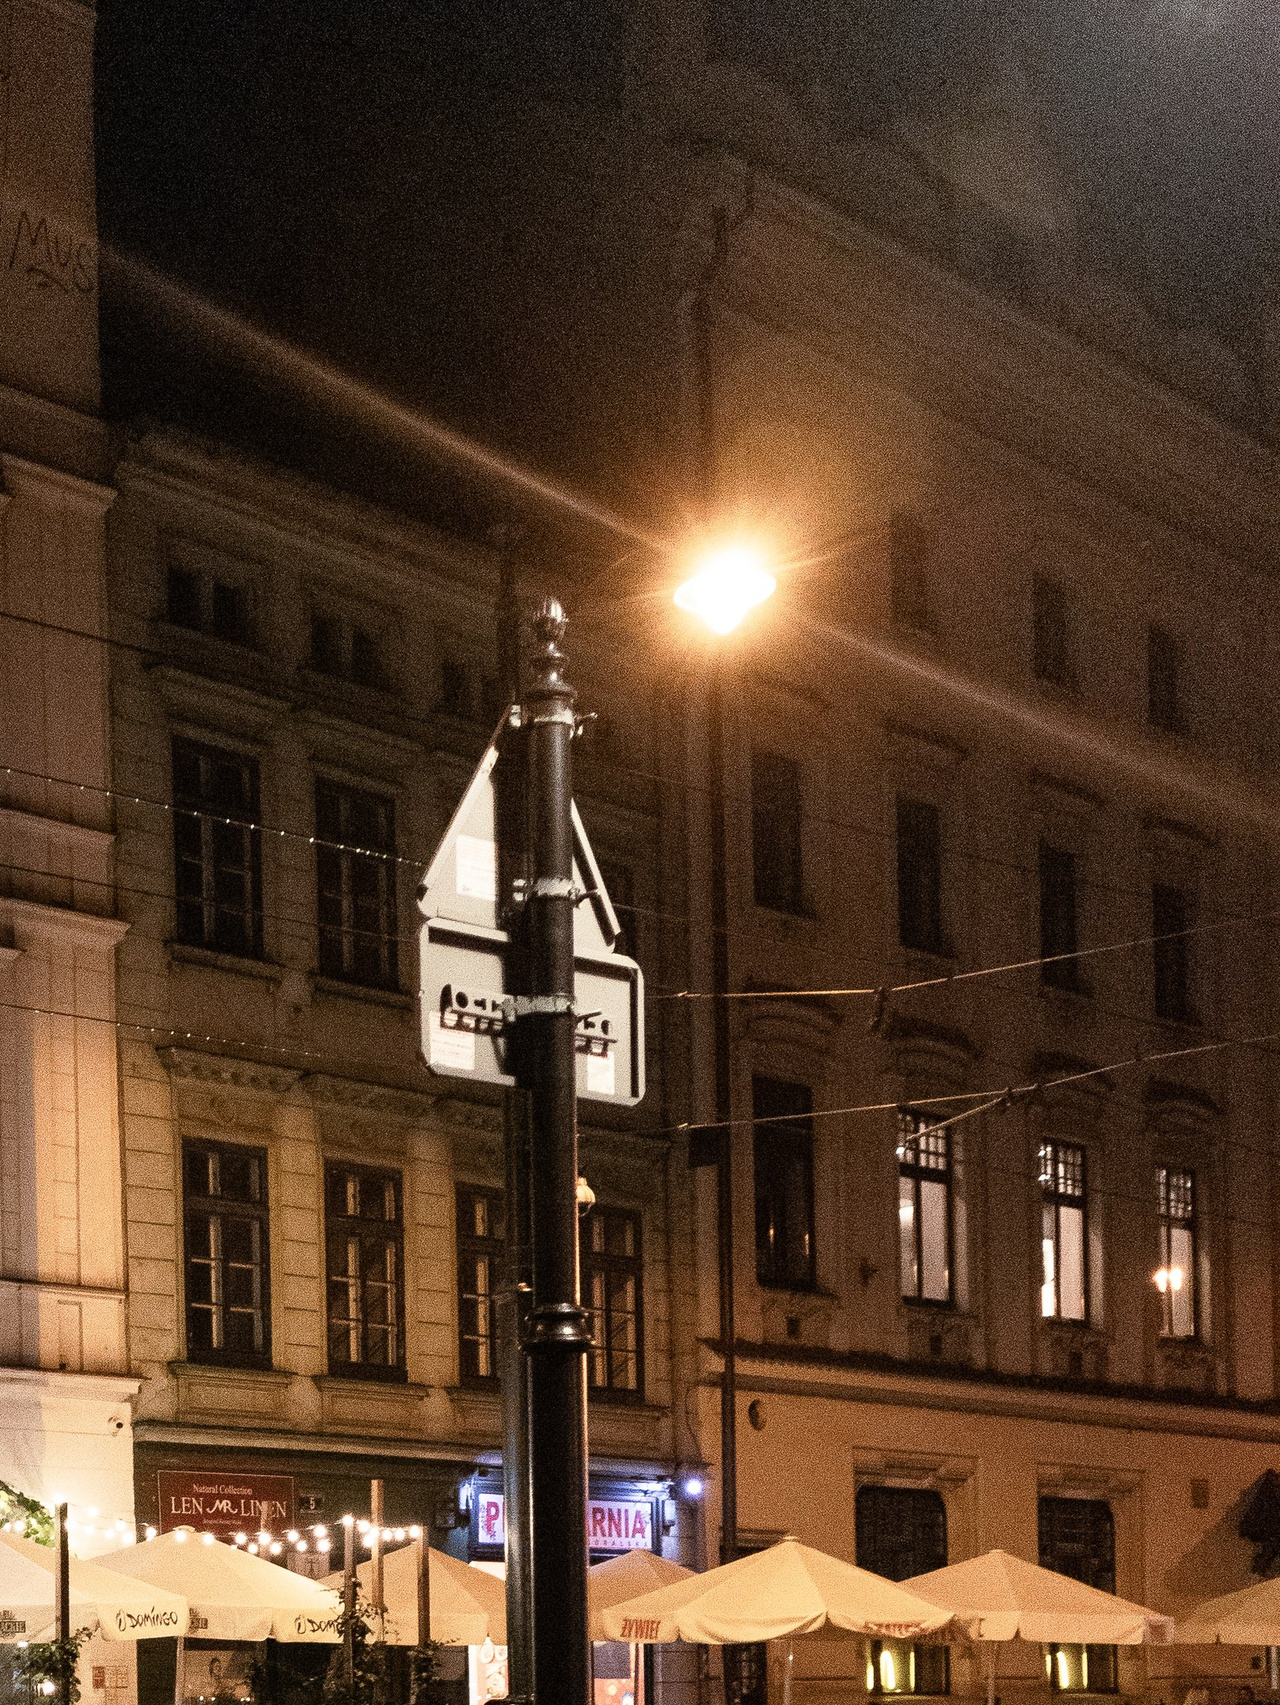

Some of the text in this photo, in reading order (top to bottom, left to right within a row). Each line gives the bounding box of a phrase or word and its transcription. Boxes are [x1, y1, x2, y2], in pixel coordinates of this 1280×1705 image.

[192, 1483, 254, 1496] Natural Collection
[171, 1496, 204, 1515] LEN
